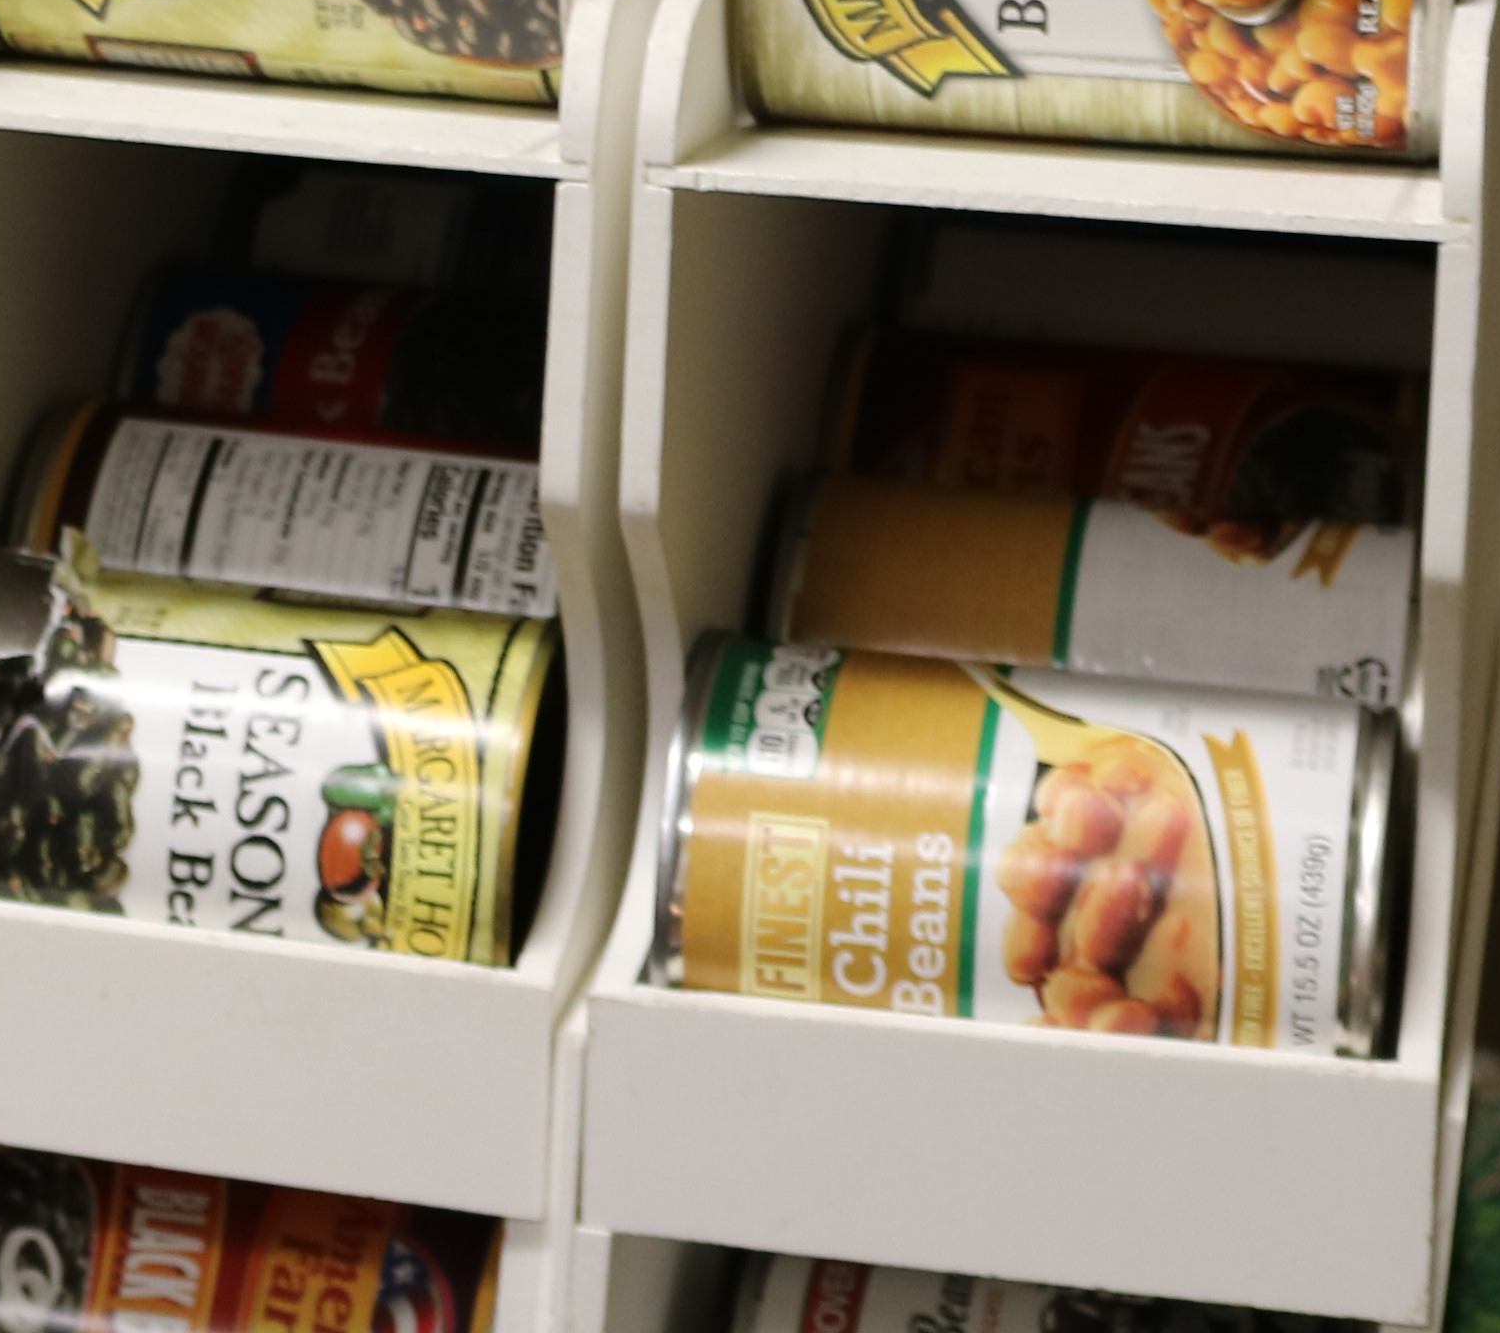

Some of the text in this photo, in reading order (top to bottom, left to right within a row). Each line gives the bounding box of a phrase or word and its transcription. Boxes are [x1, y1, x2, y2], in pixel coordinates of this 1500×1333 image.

[755, 828, 820, 991] FINEST
[833, 842, 893, 998] Chili
[893, 832, 954, 1016] Beans
[1293, 914, 1321, 1006] 15.5 OZ
